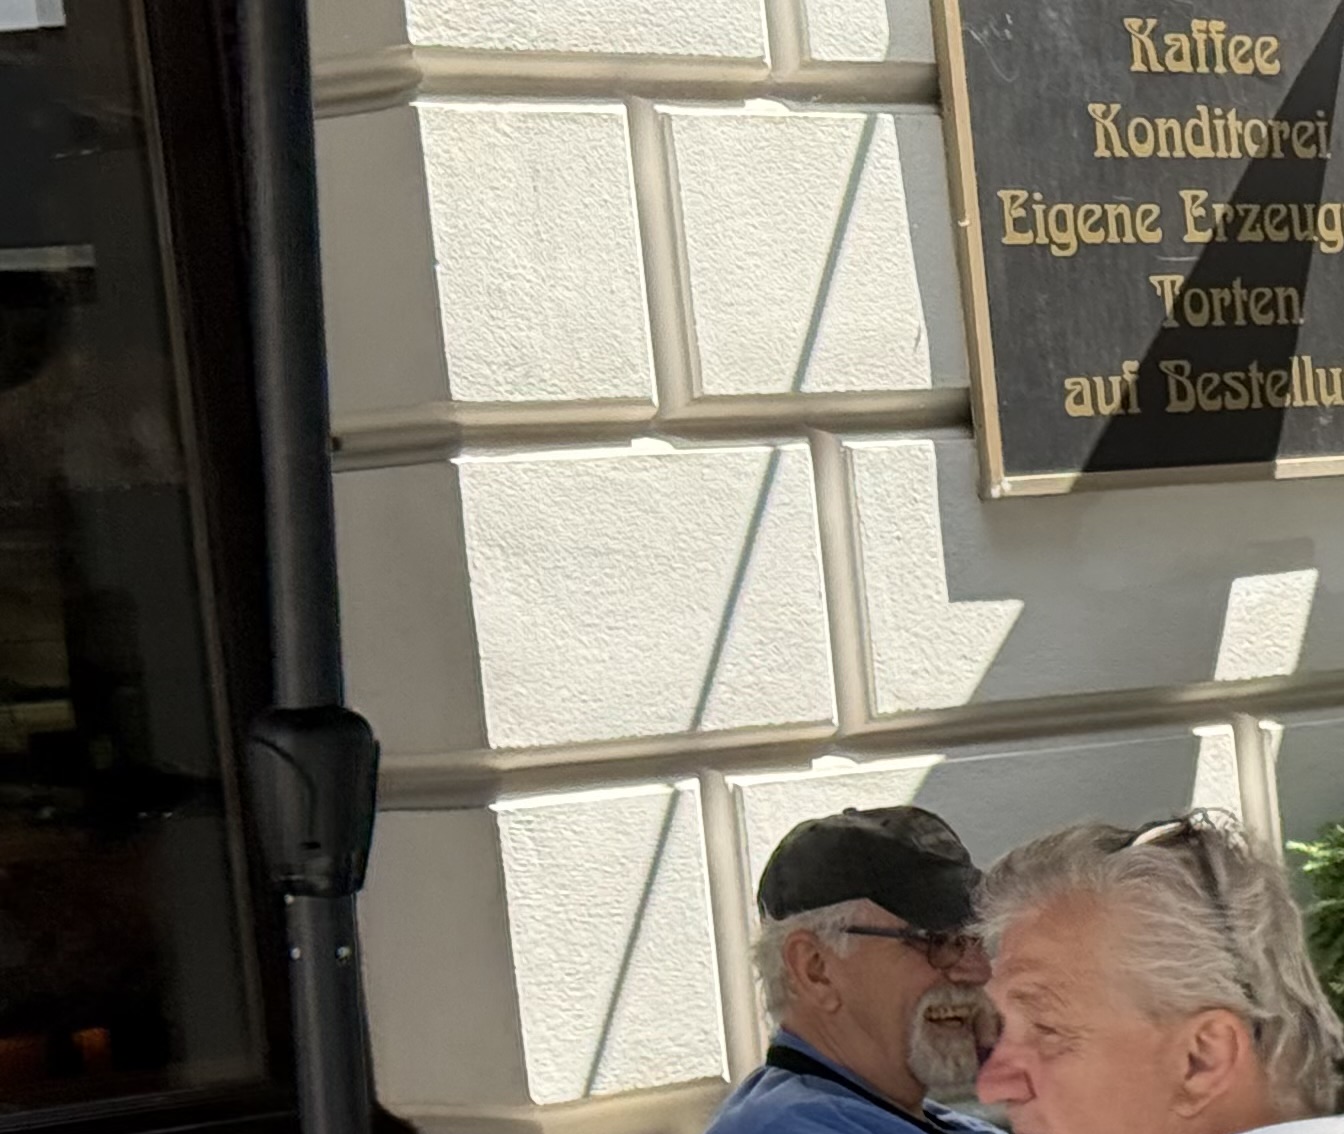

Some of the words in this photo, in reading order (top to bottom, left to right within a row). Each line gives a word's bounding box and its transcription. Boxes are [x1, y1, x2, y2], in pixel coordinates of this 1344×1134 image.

[1123, 17, 1280, 76] Kaffee
[1088, 103, 1331, 159] Konditorei
[997, 189, 1163, 257] Eigene
[1149, 274, 1304, 328] Torten
[1064, 361, 1141, 417] auf
